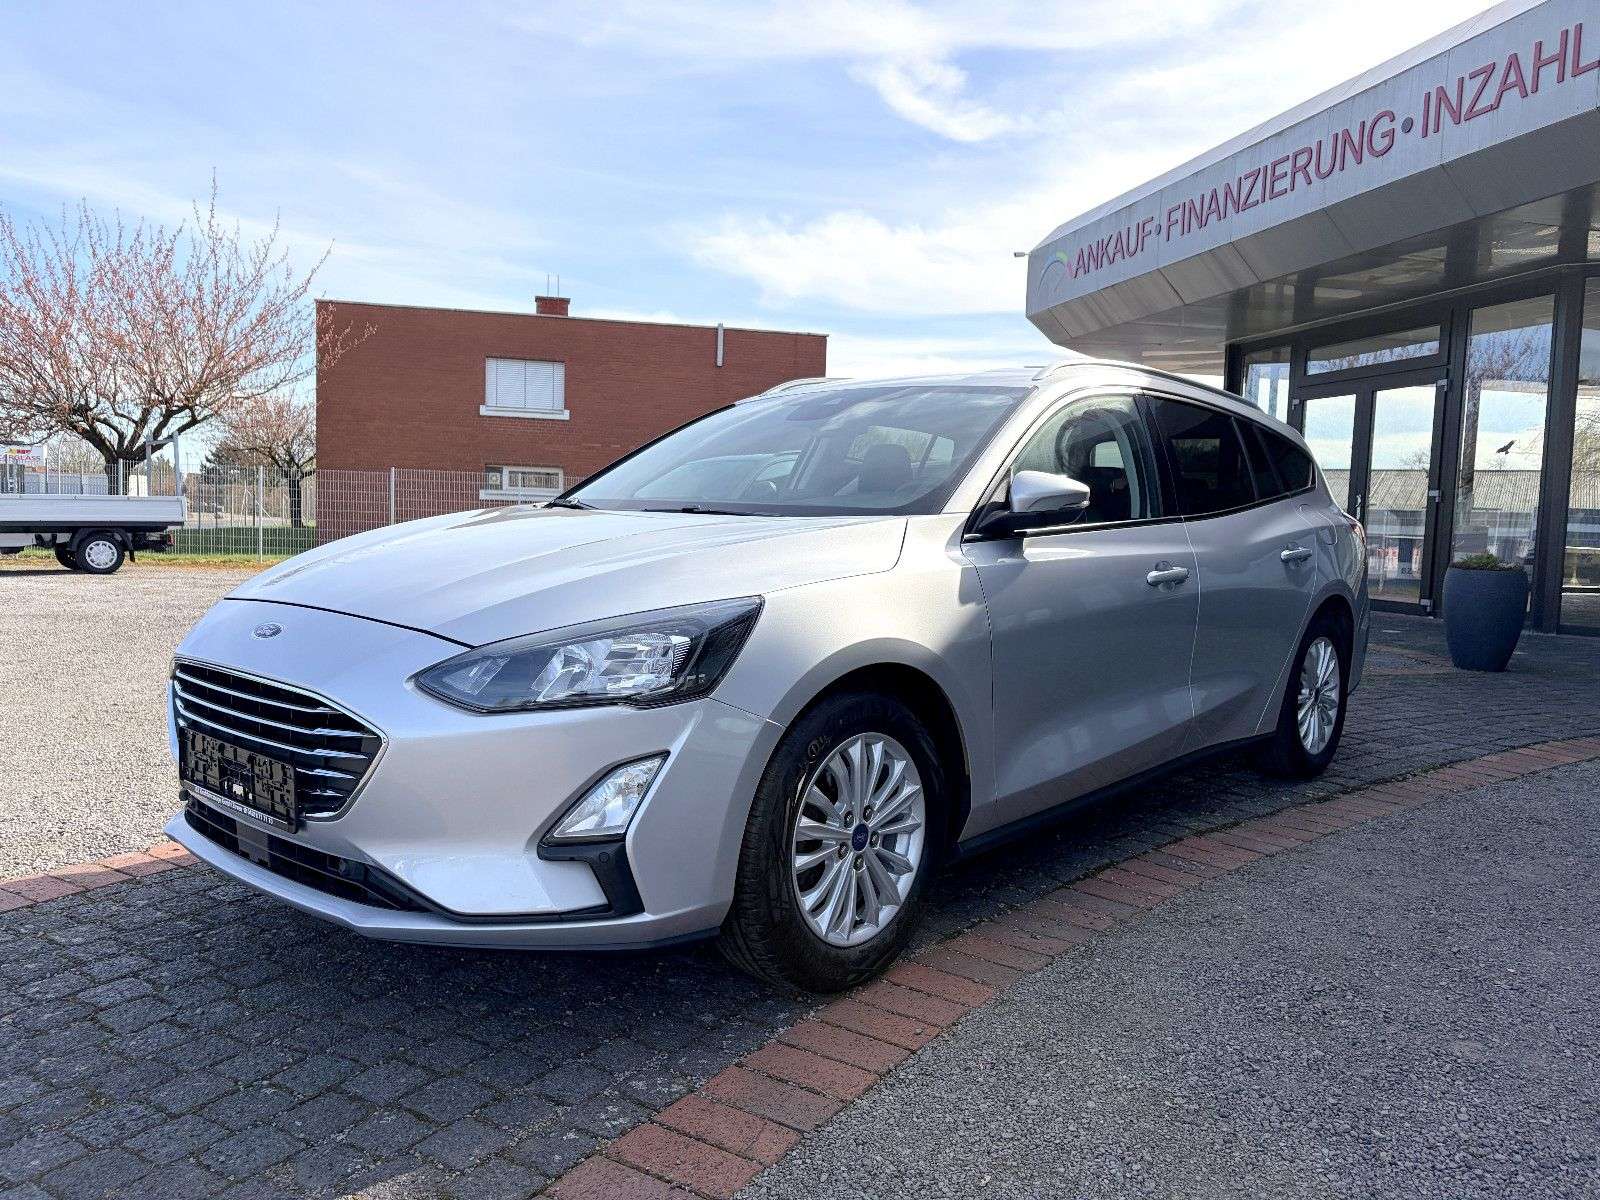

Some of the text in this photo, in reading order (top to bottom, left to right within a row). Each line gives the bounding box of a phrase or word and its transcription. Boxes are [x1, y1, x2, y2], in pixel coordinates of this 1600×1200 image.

[1074, 23, 1600, 278] ANKAUF FINANZIERUNG INZAHL
